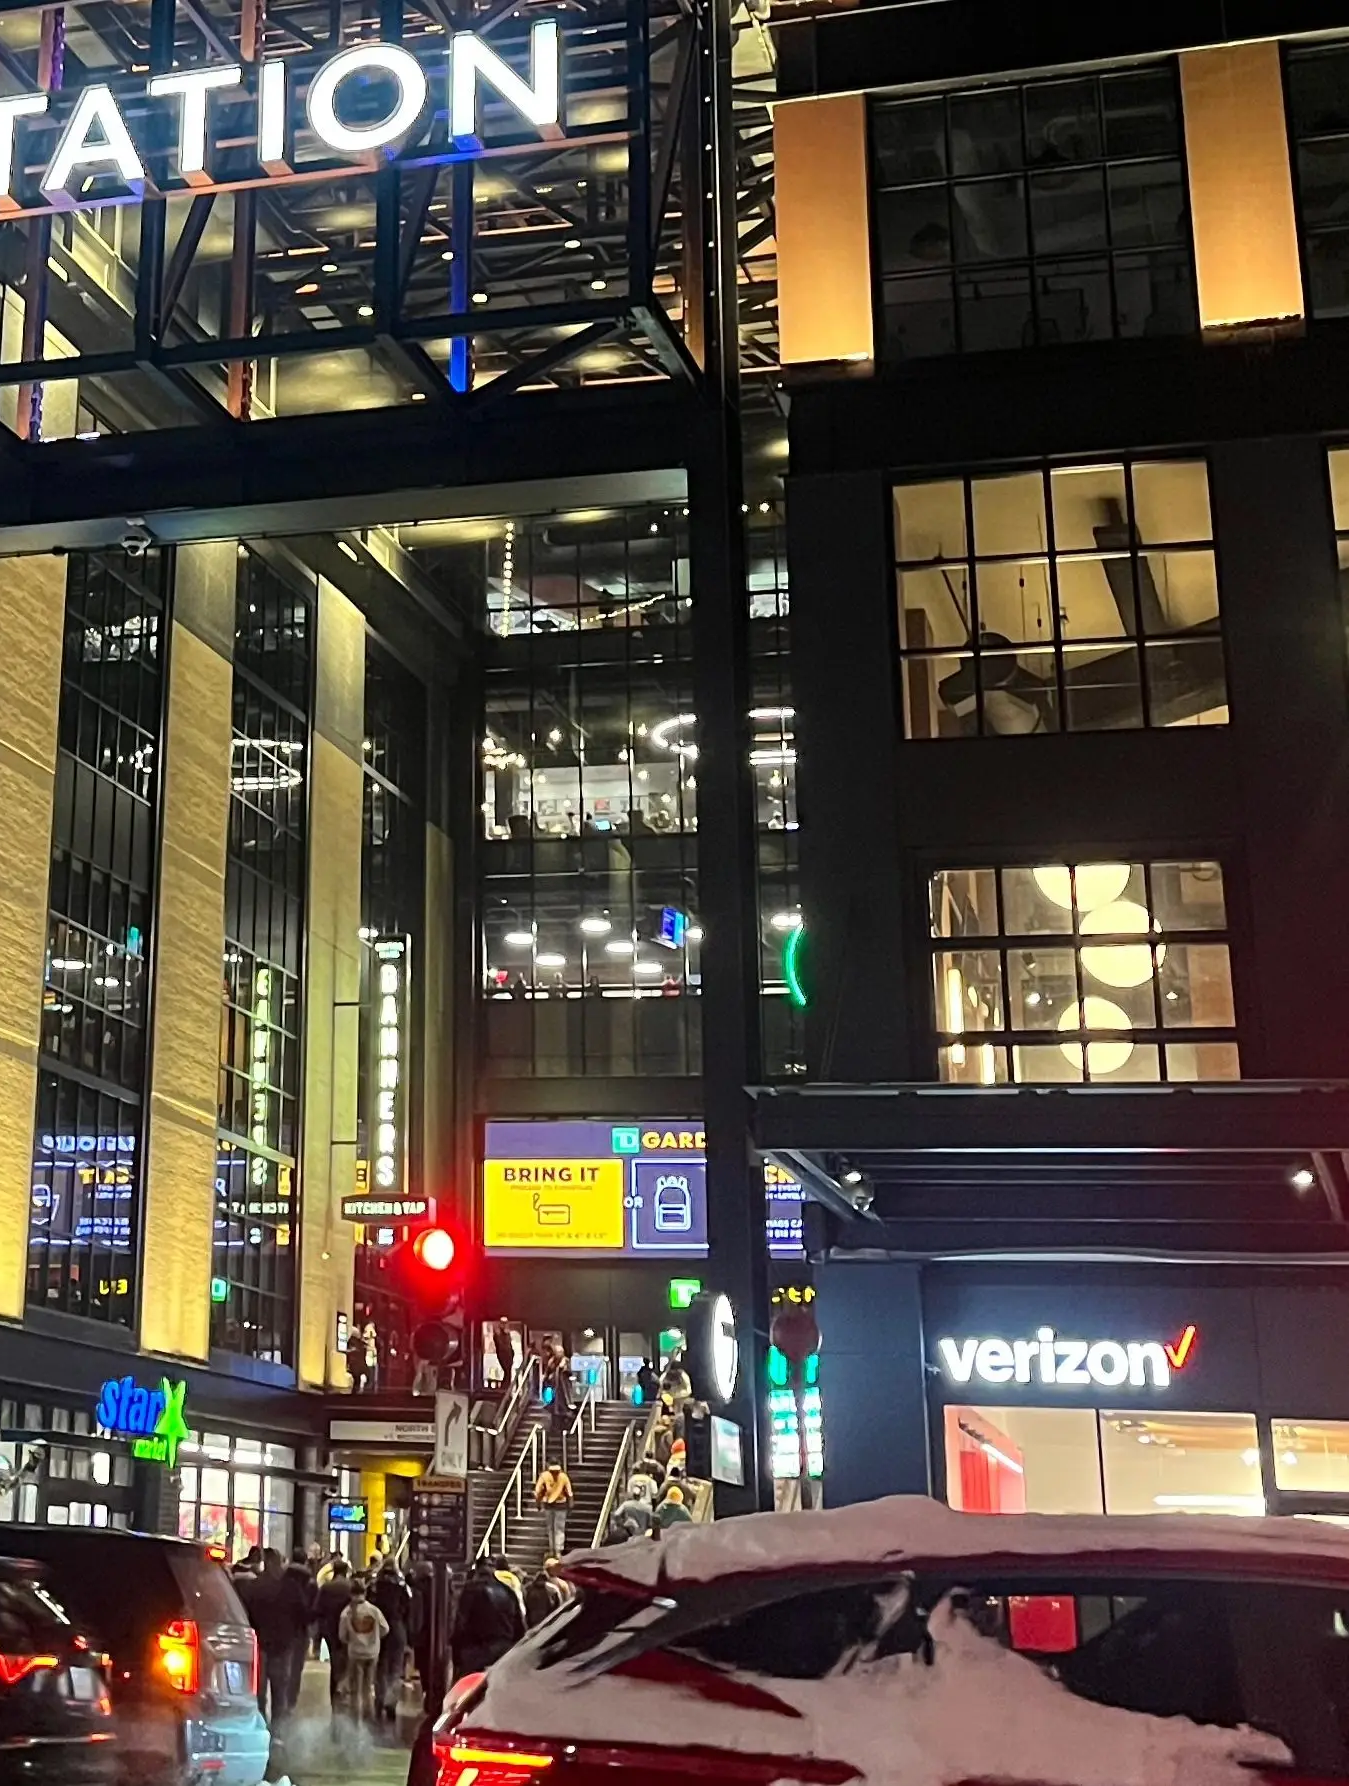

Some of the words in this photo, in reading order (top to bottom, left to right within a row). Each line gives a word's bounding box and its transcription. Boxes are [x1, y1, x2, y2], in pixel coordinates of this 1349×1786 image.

[504, 1167, 573, 1182] BRING
[580, 1167, 601, 1182] IT
[402, 1202, 426, 1214] TAP
[623, 1195, 644, 1209] OR
[940, 1327, 1169, 1387] verizon
[395, 1424, 429, 1433] NORTH
[441, 1451, 464, 1469] ONLY
